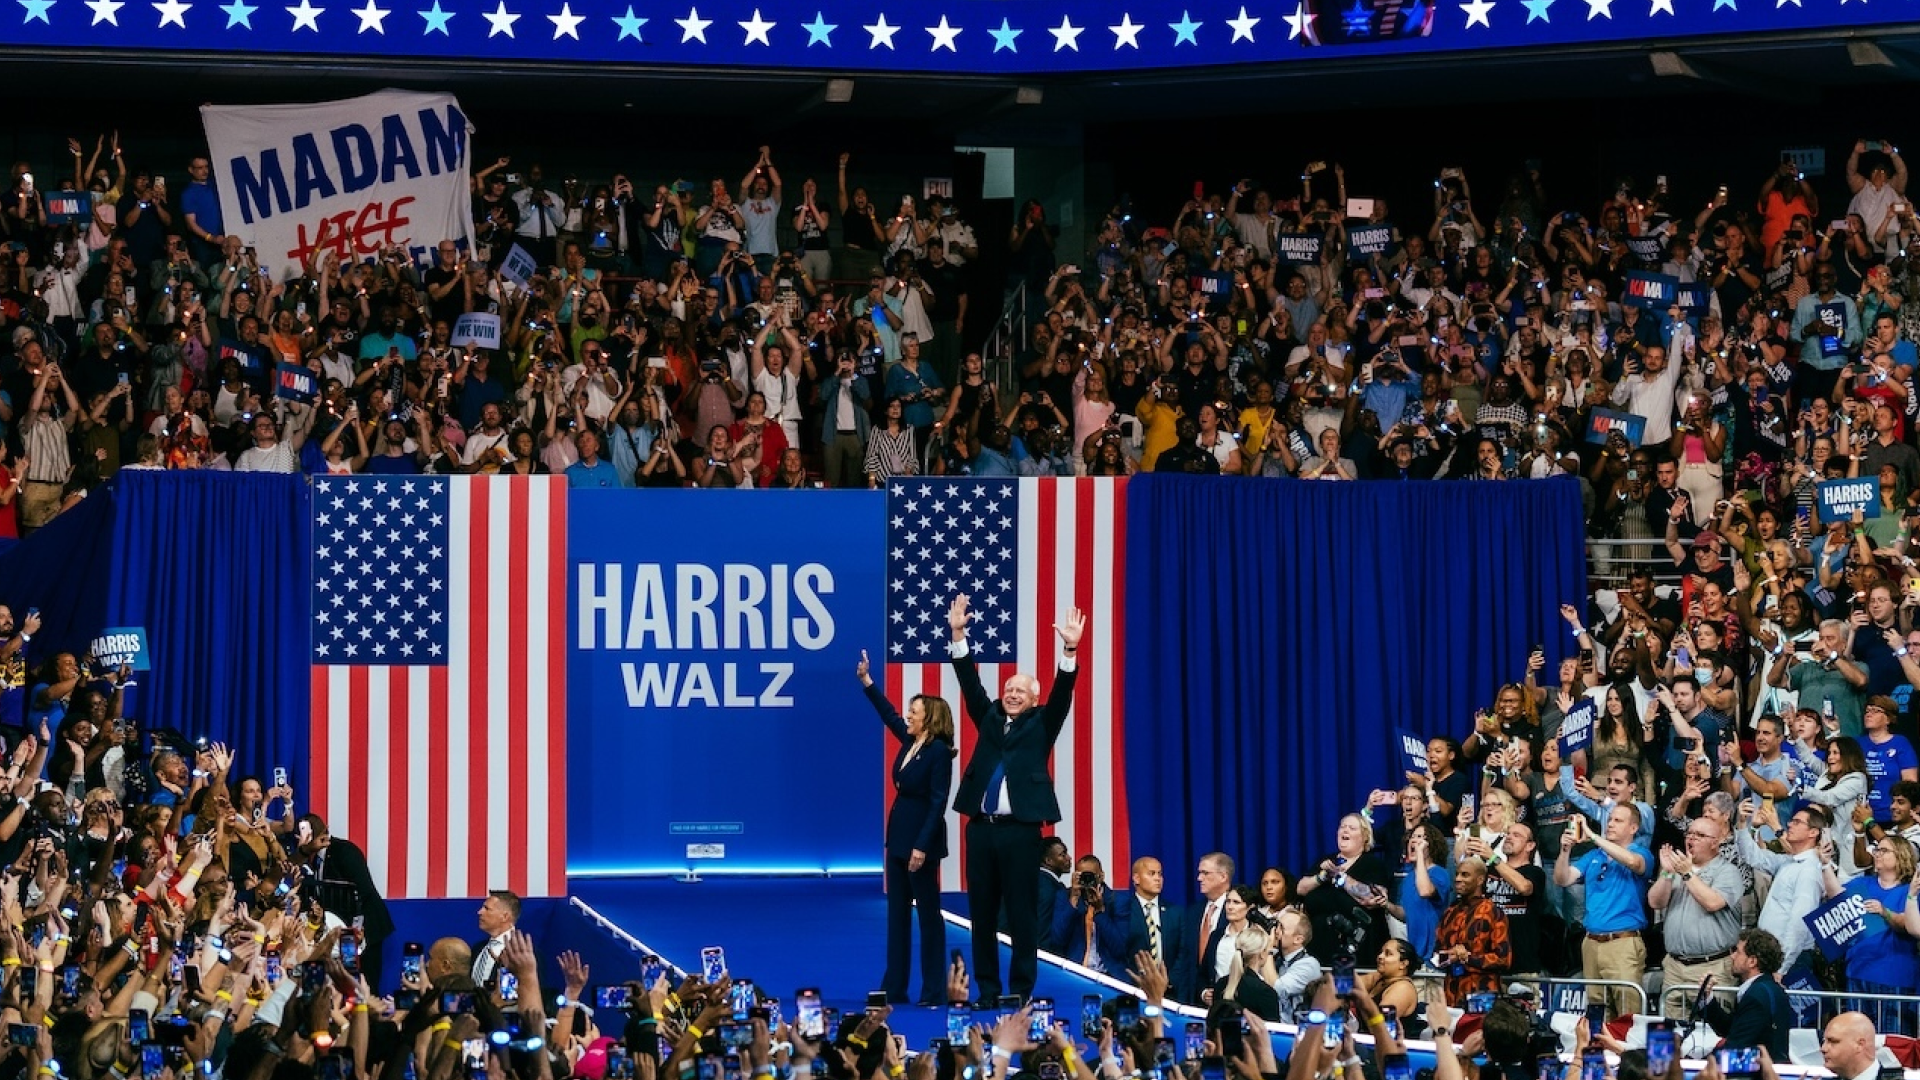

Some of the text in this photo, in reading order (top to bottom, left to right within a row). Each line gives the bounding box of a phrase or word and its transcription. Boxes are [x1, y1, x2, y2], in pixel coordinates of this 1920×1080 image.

[230, 104, 466, 224] MADAM
[929, 181, 949, 195] EXIT
[289, 196, 416, 271] VICE
[1351, 228, 1389, 247] HARRIS
[1281, 237, 1319, 252] HARRIS
[1359, 243, 1385, 254] WALZ
[1286, 251, 1313, 262] WALZ
[1629, 278, 1674, 299] KAMALA
[1677, 290, 1705, 307] MALA
[457, 324, 495, 339] WE WIN
[1824, 482, 1873, 505] HARRIS
[1833, 502, 1866, 515] WALZ
[578, 562, 836, 650] HARRIS
[91, 633, 141, 657] HARRIS
[100, 653, 135, 667] WALZ
[620, 662, 794, 707] WALZ
[1566, 728, 1587, 747] WALZ
[1813, 894, 1867, 939] HARRIS
[1832, 918, 1867, 946] WALZ
